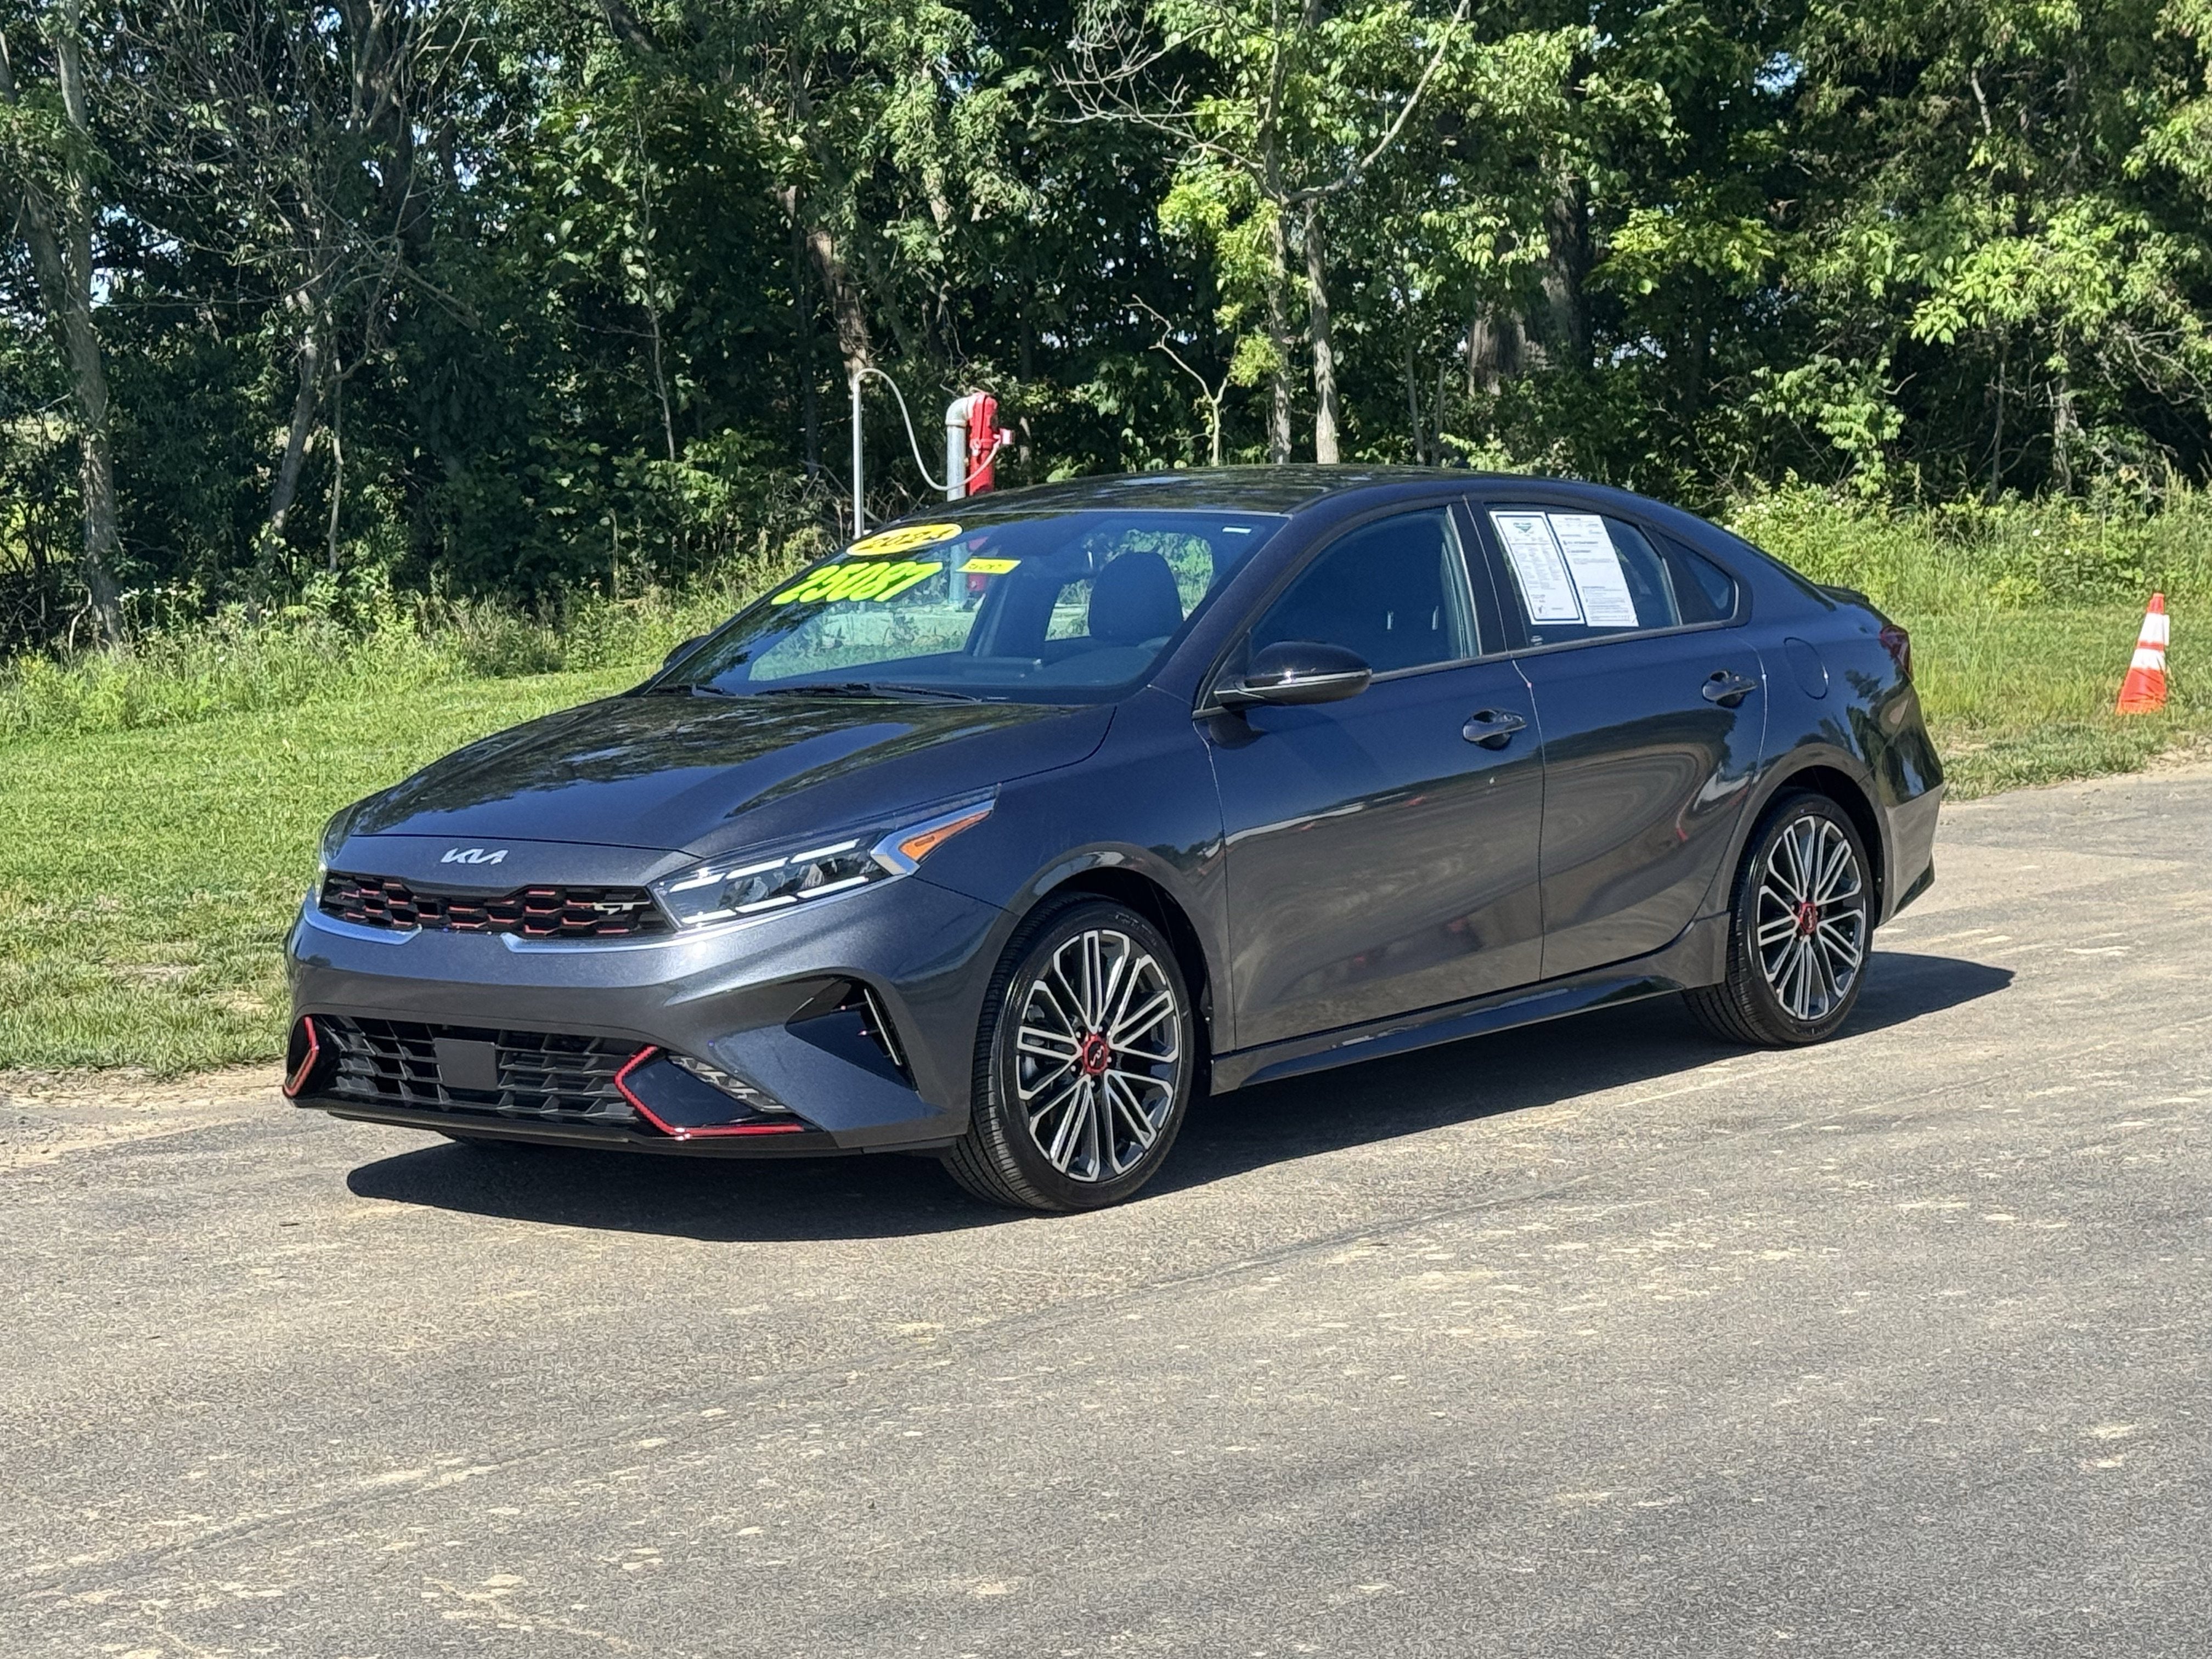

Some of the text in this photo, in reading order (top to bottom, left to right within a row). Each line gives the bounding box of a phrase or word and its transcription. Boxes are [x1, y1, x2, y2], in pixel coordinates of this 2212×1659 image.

[770, 561, 943, 605] 25087
[440, 848, 509, 865] KIA
[593, 901, 651, 916] GT
